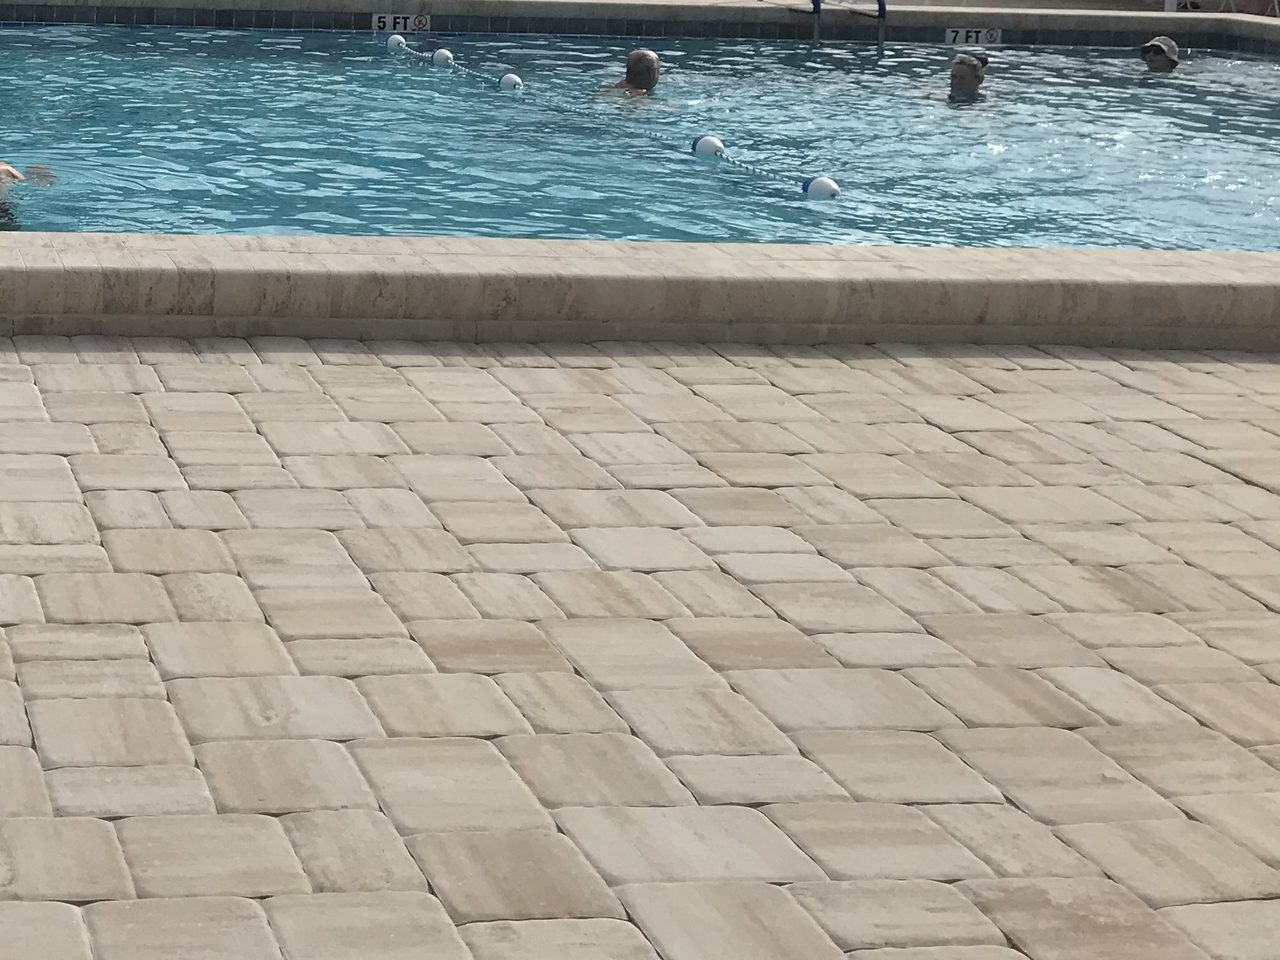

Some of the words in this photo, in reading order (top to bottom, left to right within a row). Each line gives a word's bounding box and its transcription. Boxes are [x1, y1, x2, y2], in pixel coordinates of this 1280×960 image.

[377, 15, 387, 30] 5
[393, 15, 410, 31] FT
[951, 29, 960, 43] 7
[965, 29, 982, 44] FT
